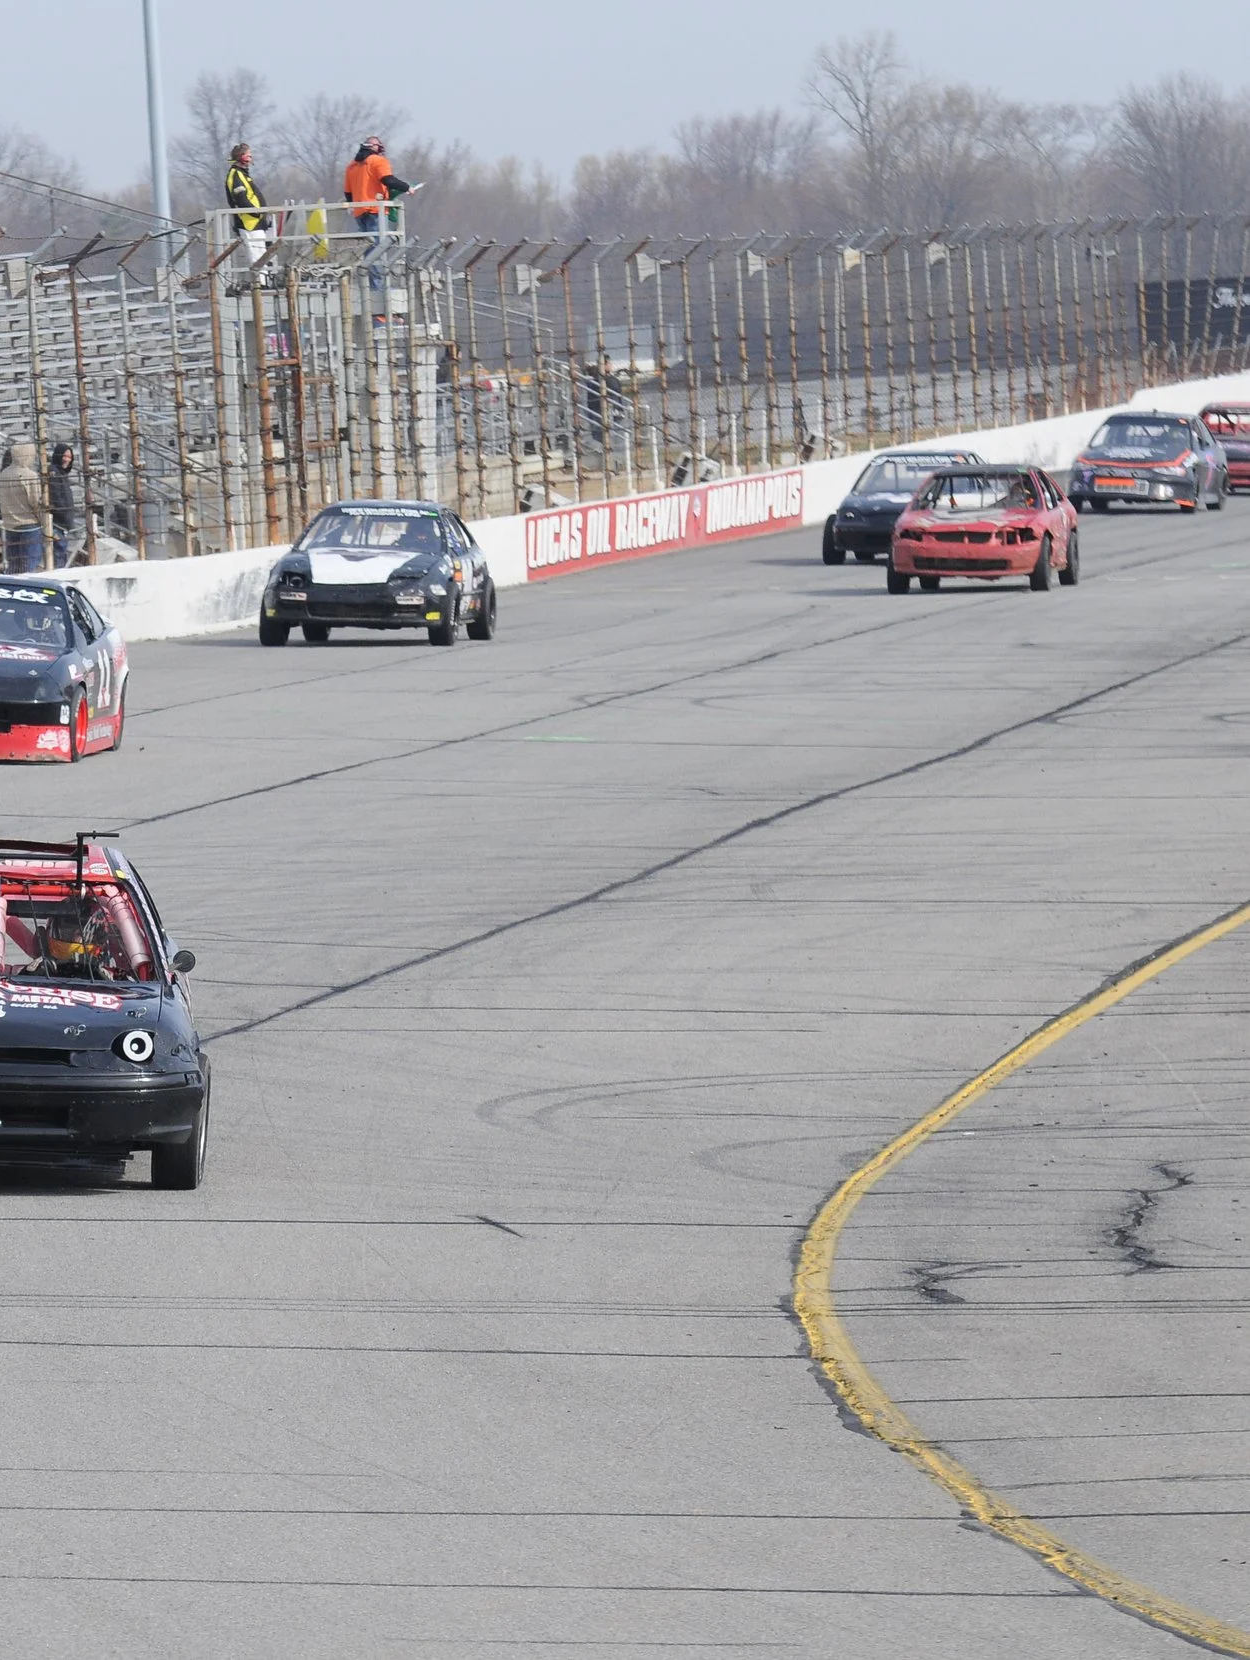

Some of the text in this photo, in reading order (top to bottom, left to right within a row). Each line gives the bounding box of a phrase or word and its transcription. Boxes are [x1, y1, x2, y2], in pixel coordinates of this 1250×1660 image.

[527, 473, 801, 568] LUCAS OIL RACEWAY INDIANAPOLIS
[96, 648, 111, 708] 11
[11, 994, 76, 1007] METAL
